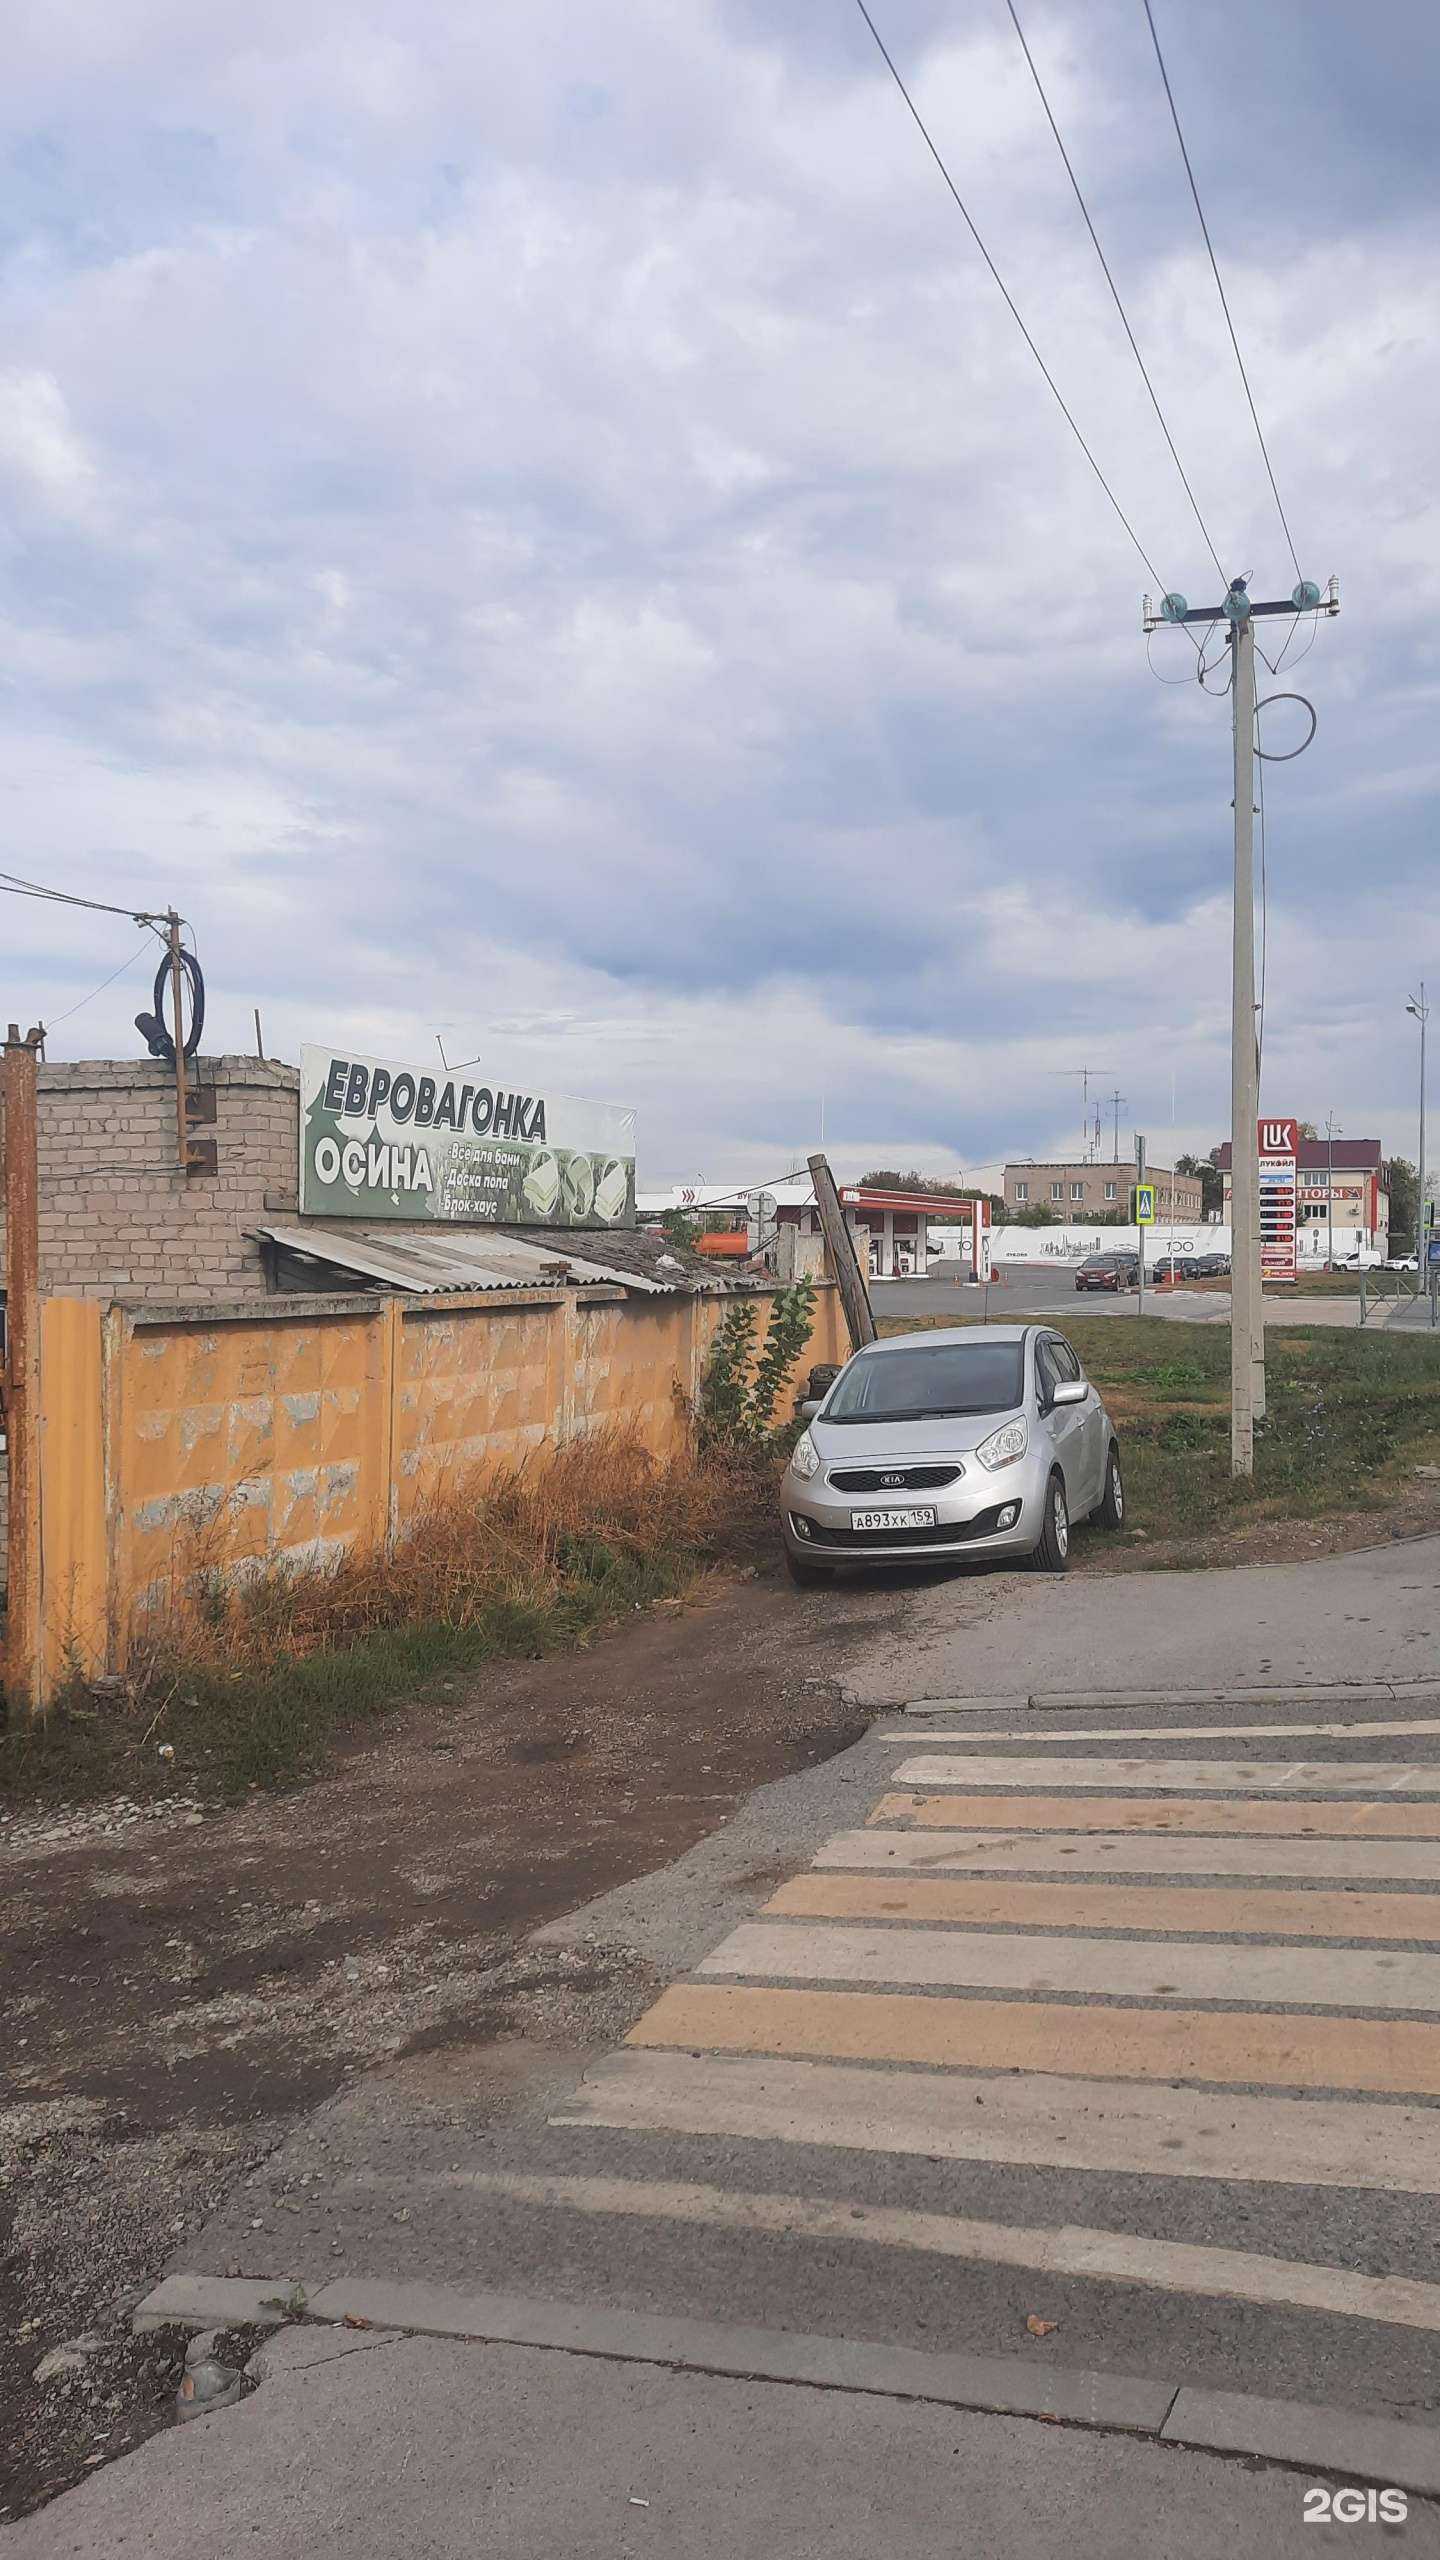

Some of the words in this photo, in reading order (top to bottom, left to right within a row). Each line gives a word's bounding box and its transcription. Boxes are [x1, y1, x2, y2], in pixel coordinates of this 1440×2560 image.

[323, 1058, 547, 1144] ЕВРОВАГОНКА
[314, 1136, 434, 1193] ОСИНА
[473, 1148, 493, 1163] для
[495, 1148, 520, 1166] бани
[1260, 1160, 1294, 1168] ЛУКОЙЛ
[483, 1174, 509, 1190] пола
[883, 1475, 901, 1484] KIA
[911, 1510, 931, 1522] 159
